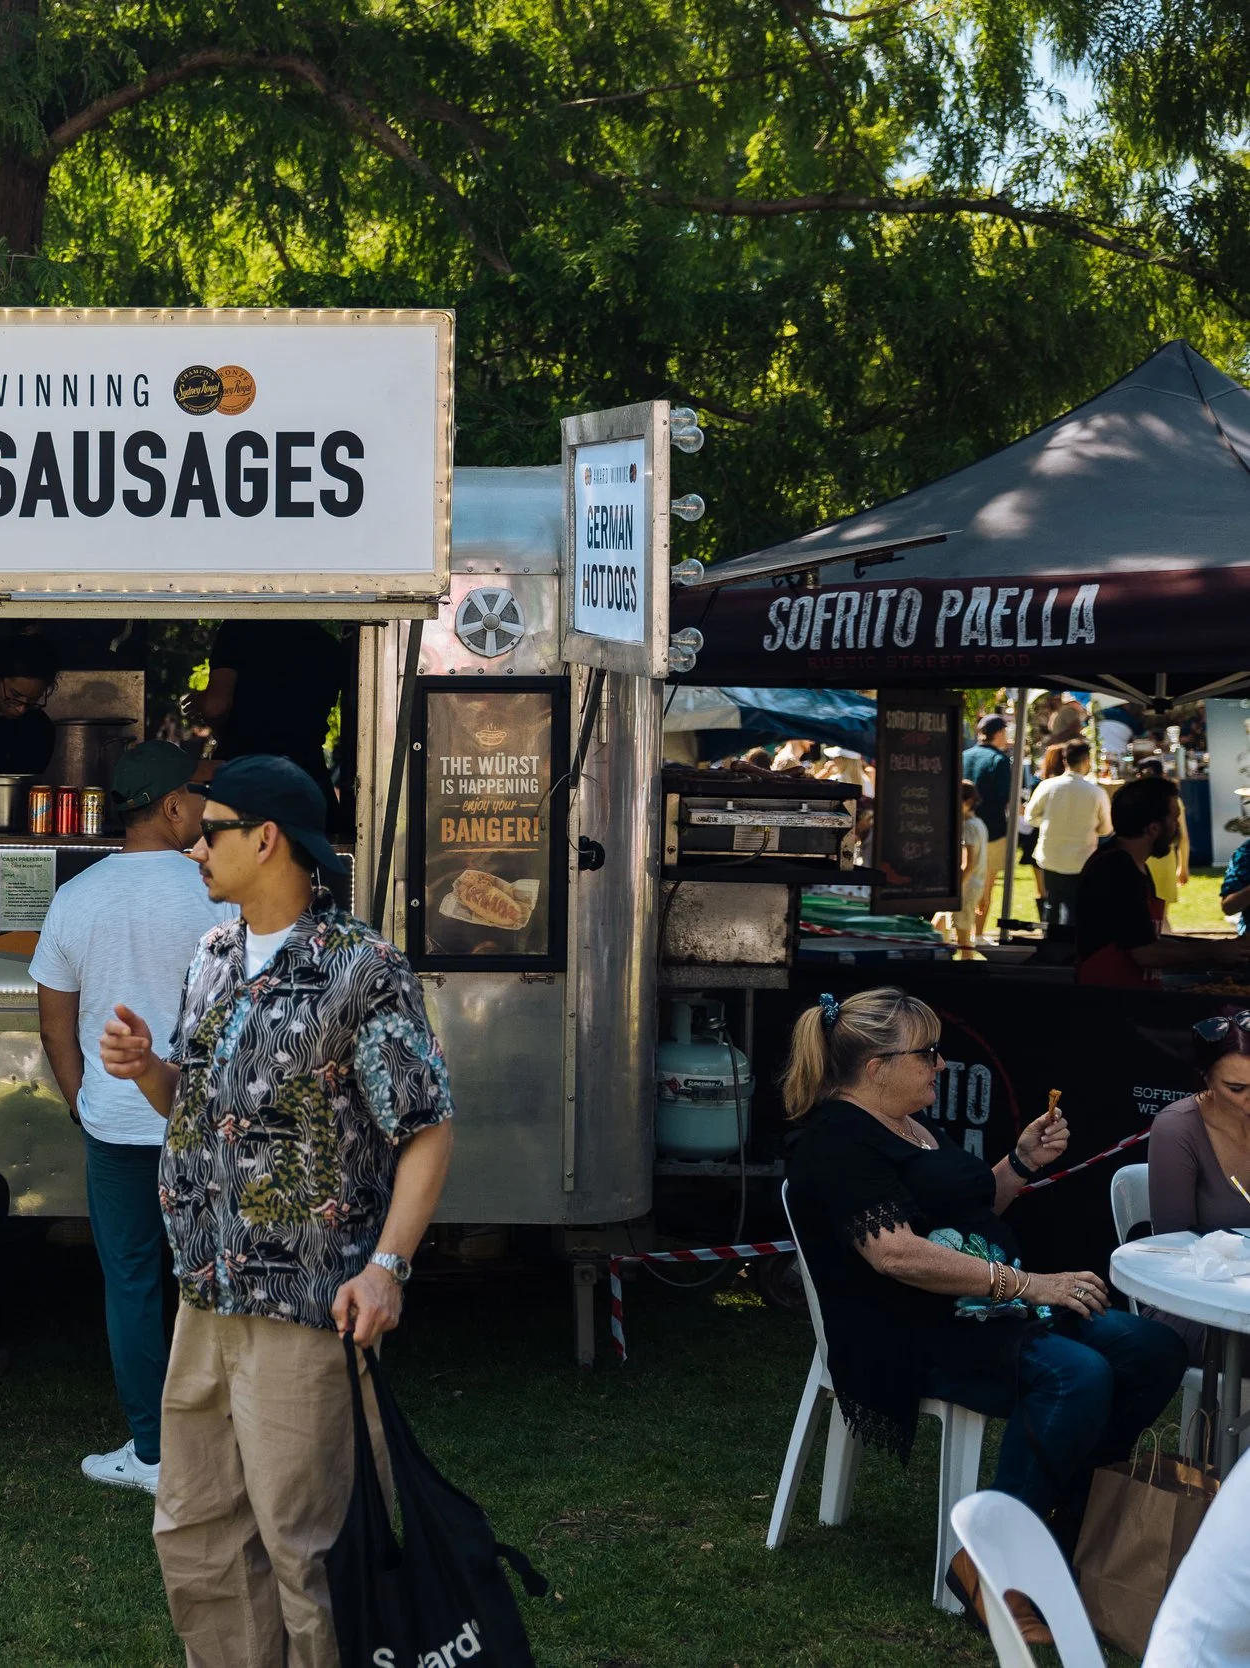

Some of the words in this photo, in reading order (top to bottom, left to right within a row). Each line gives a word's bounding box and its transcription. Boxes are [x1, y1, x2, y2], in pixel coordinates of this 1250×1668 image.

[180, 369, 215, 382] CHAMPION
[219, 369, 248, 382] RONZE
[201, 380, 220, 395] Royal
[587, 504, 634, 550] GERMAN
[582, 563, 637, 613] HOTDOGS
[763, 587, 923, 651] SOFRITO
[935, 584, 1100, 648] PAELLA
[807, 656, 876, 670] RUSTIC
[885, 655, 963, 669] STREET
[973, 654, 1031, 668] FOOD
[440, 756, 472, 776] THE
[478, 753, 539, 775] WÜRST
[441, 779, 454, 795] IS
[458, 778, 539, 794] HAPPENING
[462, 797, 489, 815] enjoy
[493, 800, 518, 814] your
[441, 816, 540, 843] BANGER!
[1137, 1102, 1160, 1115] WE
